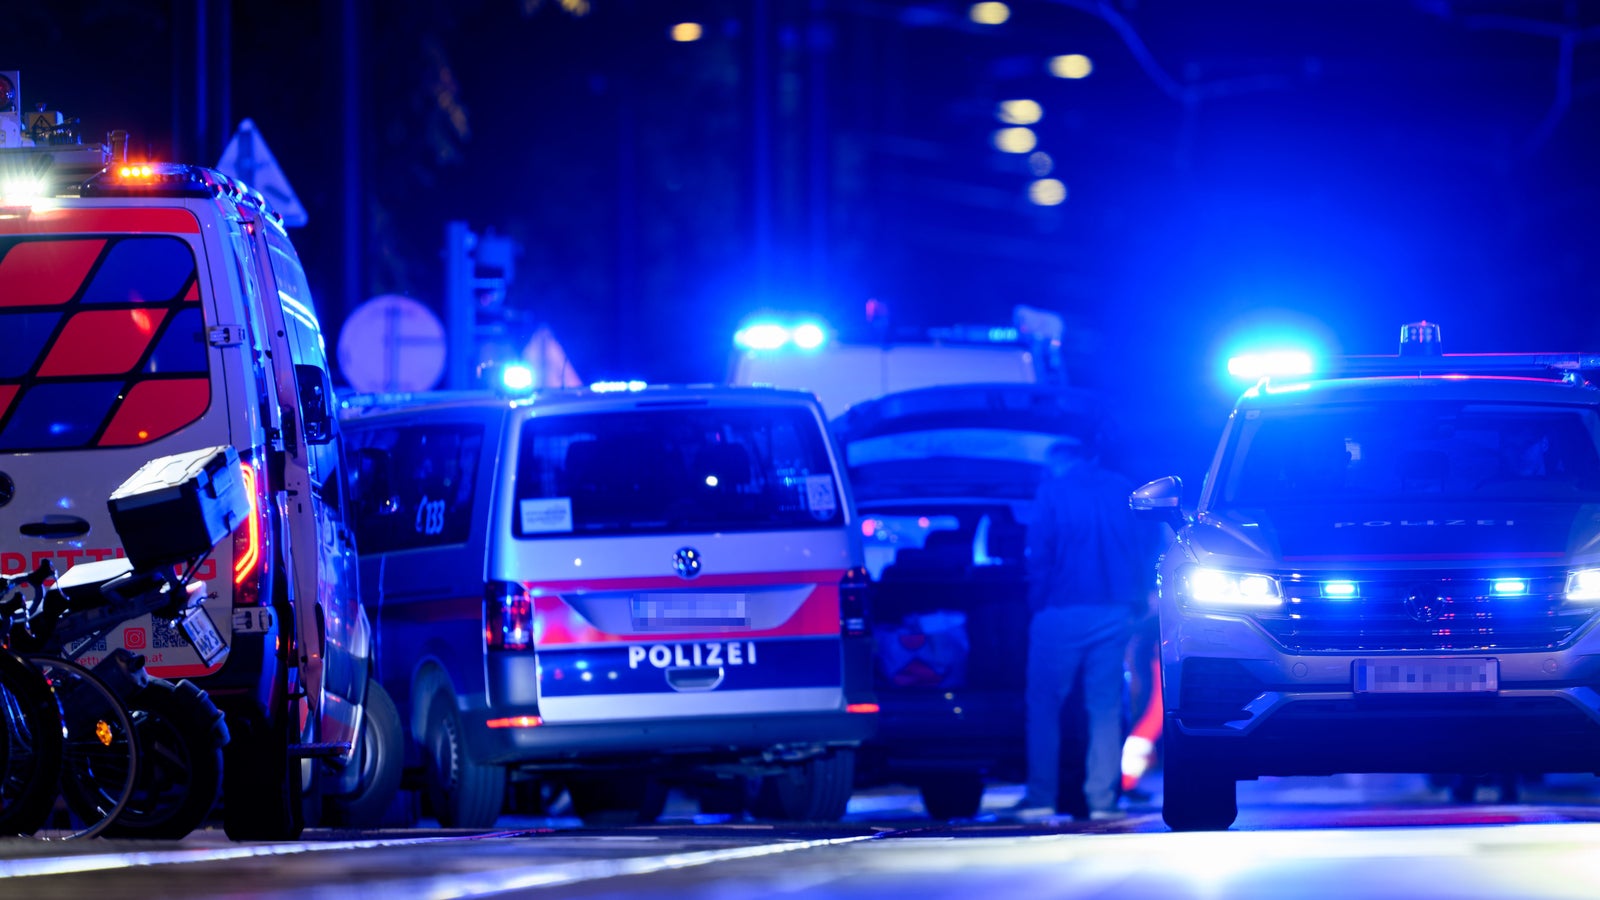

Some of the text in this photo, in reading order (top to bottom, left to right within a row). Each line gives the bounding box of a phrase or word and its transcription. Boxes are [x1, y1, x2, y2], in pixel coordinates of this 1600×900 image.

[1334, 519, 1514, 528] POLIZEI
[1, 548, 217, 587] RETTG
[628, 641, 756, 669] POLIZEI
